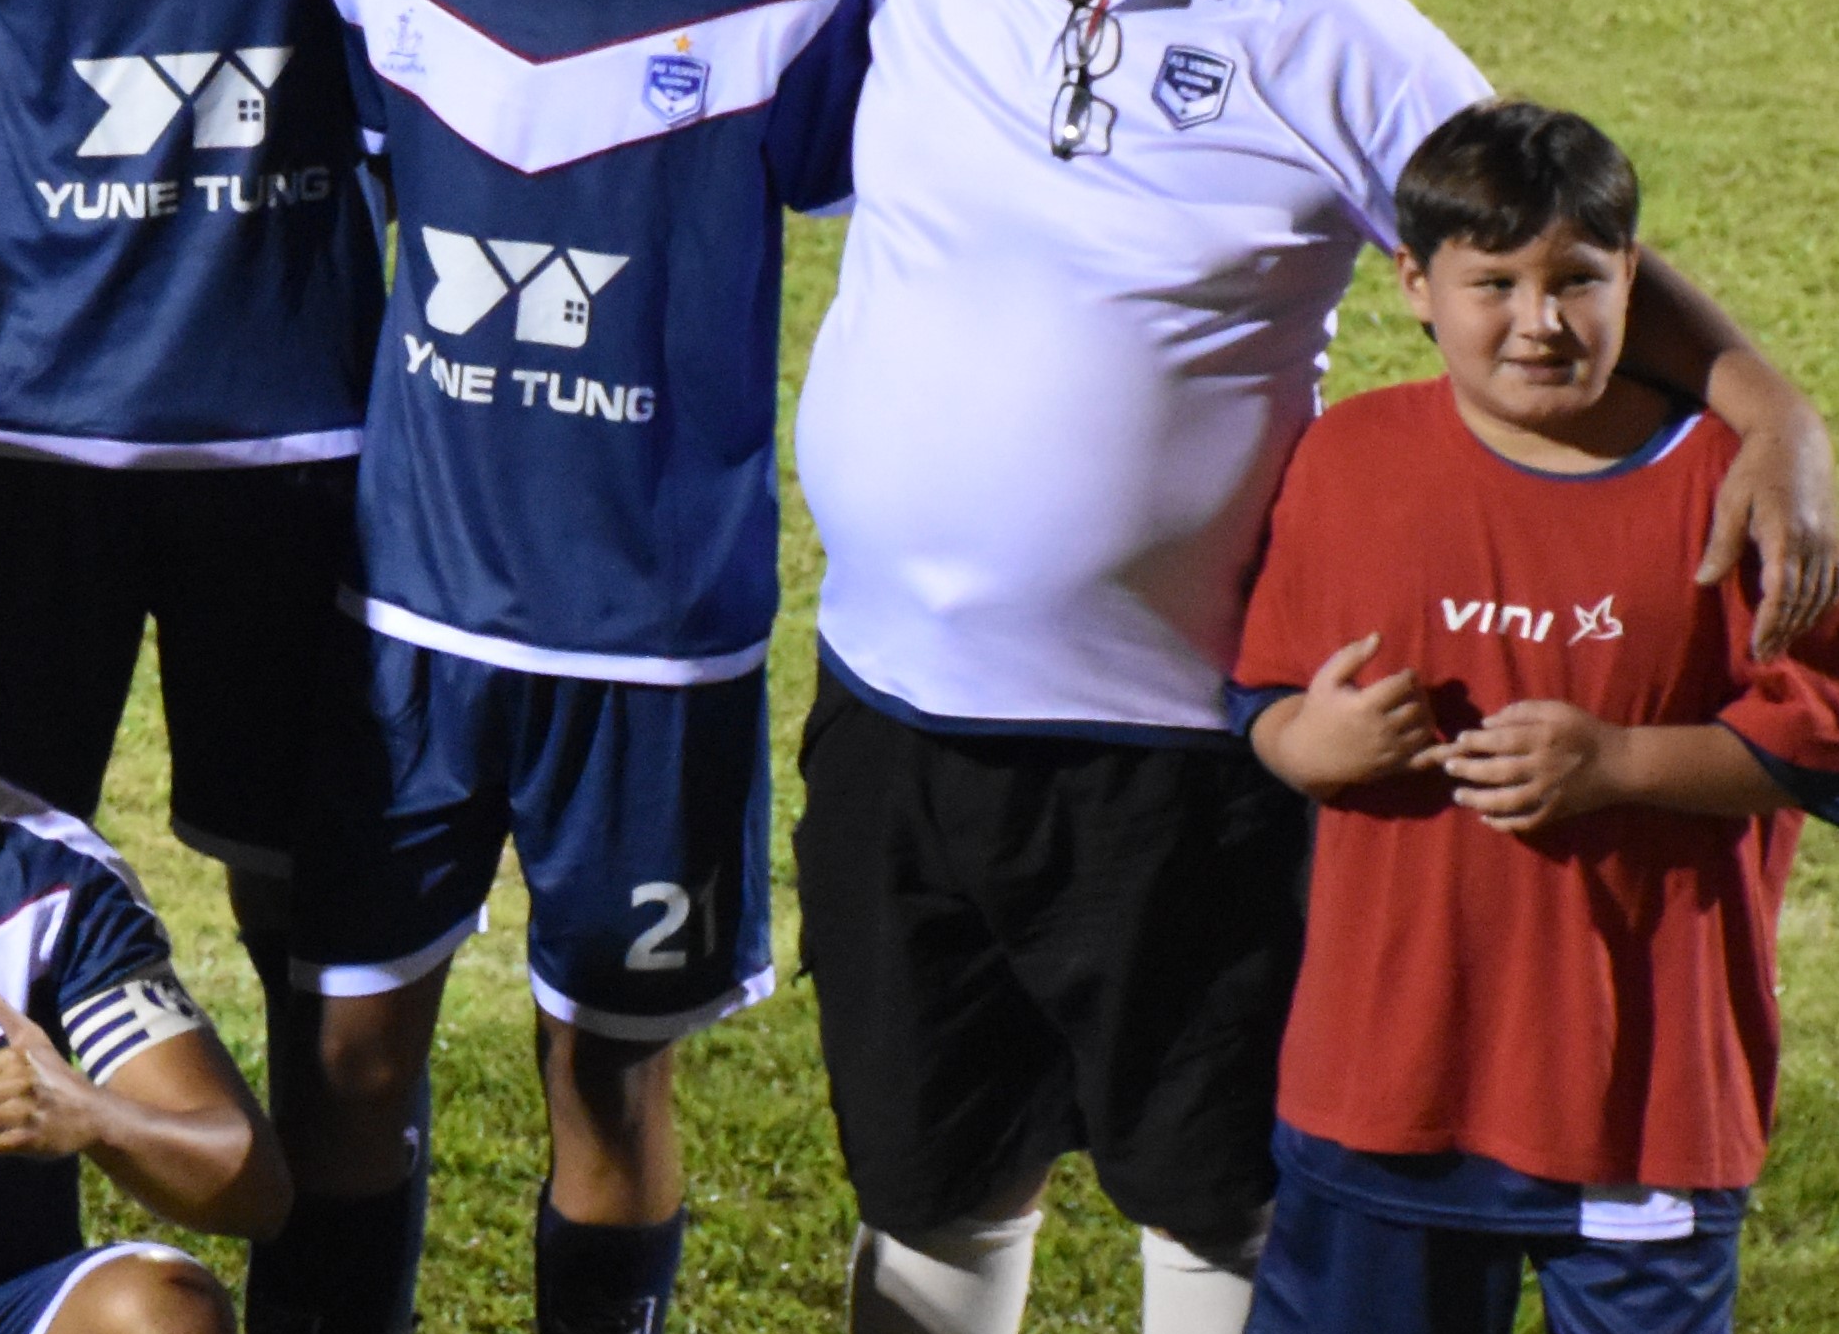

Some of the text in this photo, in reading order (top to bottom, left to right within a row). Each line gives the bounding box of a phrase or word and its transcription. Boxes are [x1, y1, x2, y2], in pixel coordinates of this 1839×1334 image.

[35, 166, 332, 219] YUNE TUNG
[511, 369, 656, 423] TUNG
